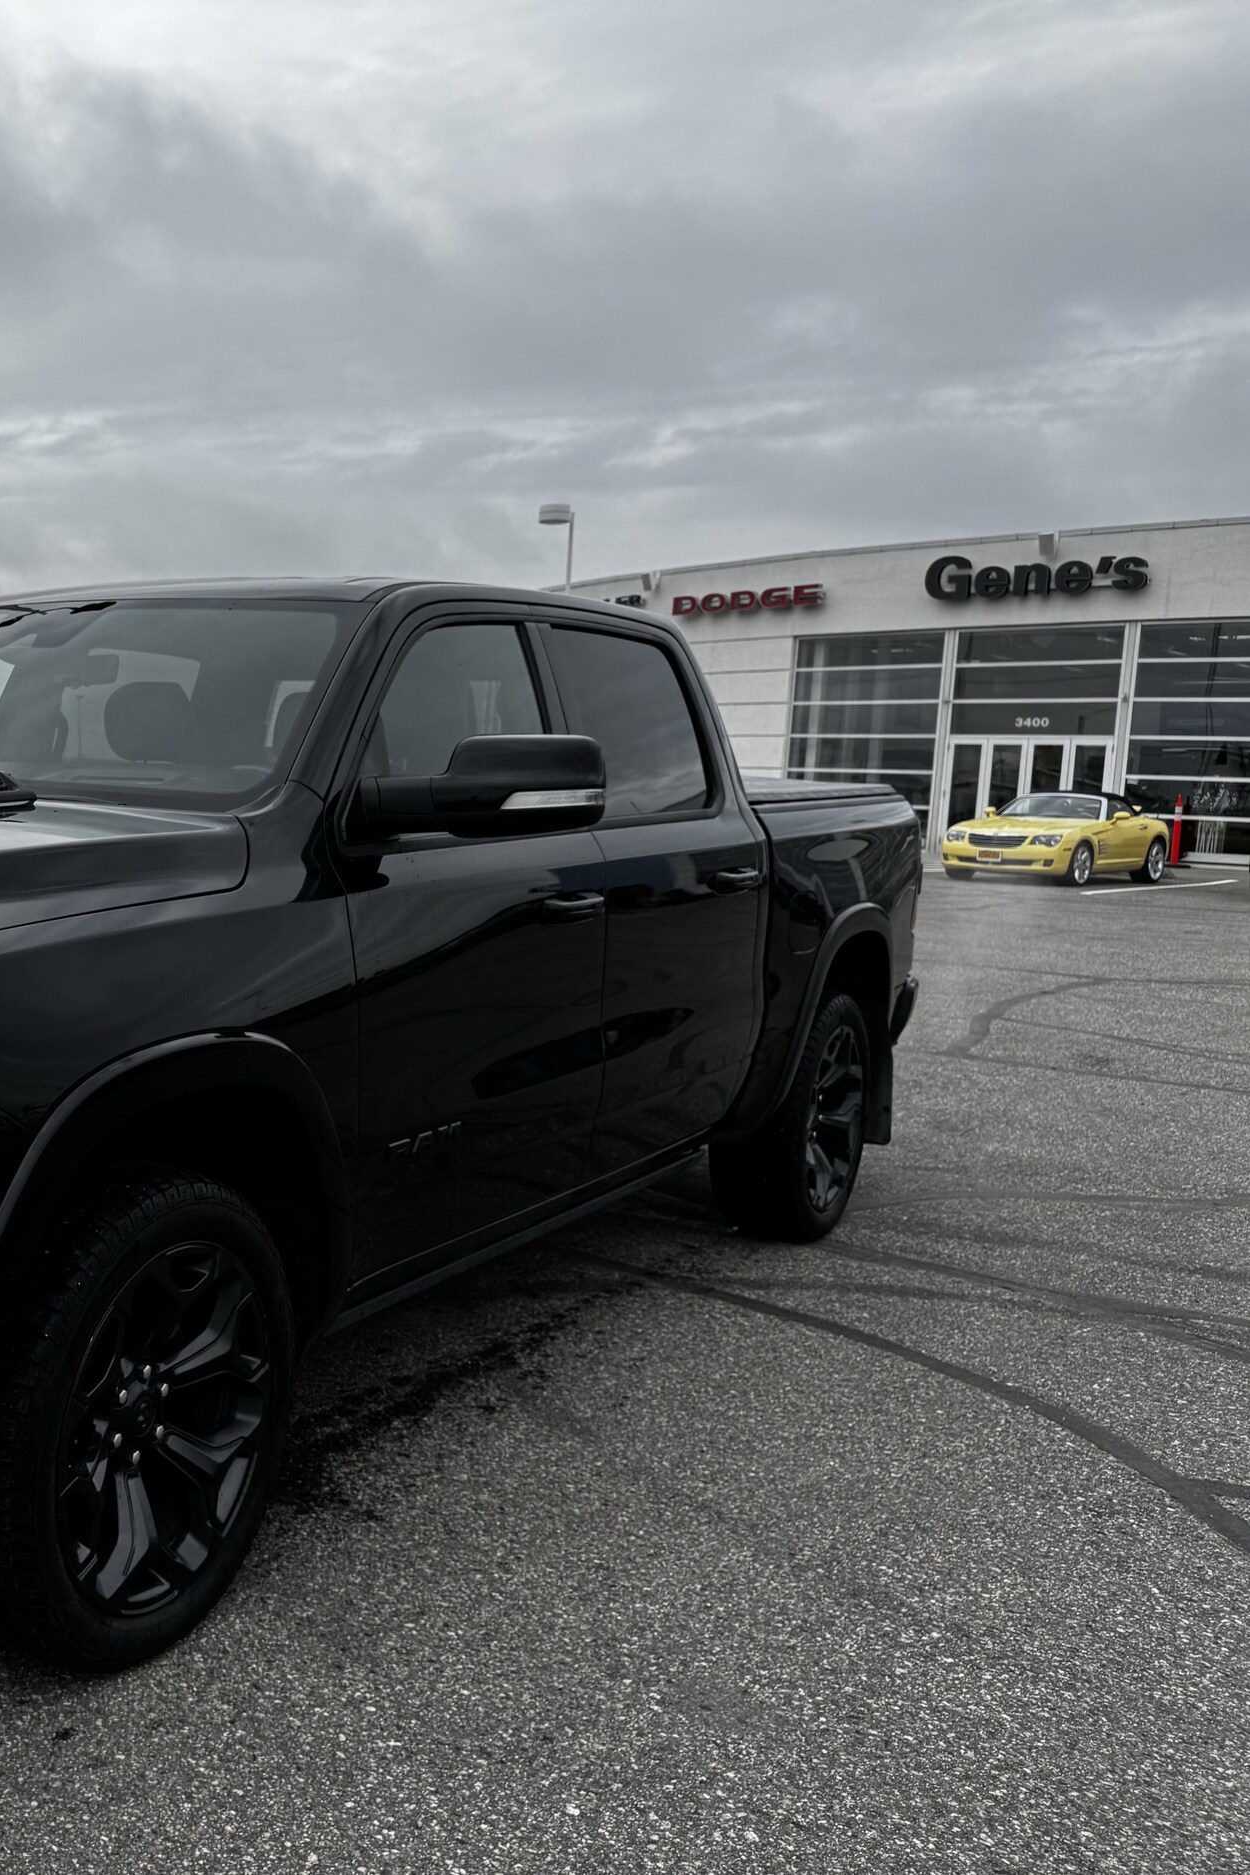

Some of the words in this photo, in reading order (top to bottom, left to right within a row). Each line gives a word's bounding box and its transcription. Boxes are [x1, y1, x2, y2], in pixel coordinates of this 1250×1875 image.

[925, 555, 1148, 600] Gene's
[672, 583, 824, 616] DODGE
[1015, 716, 1049, 728] 3400
